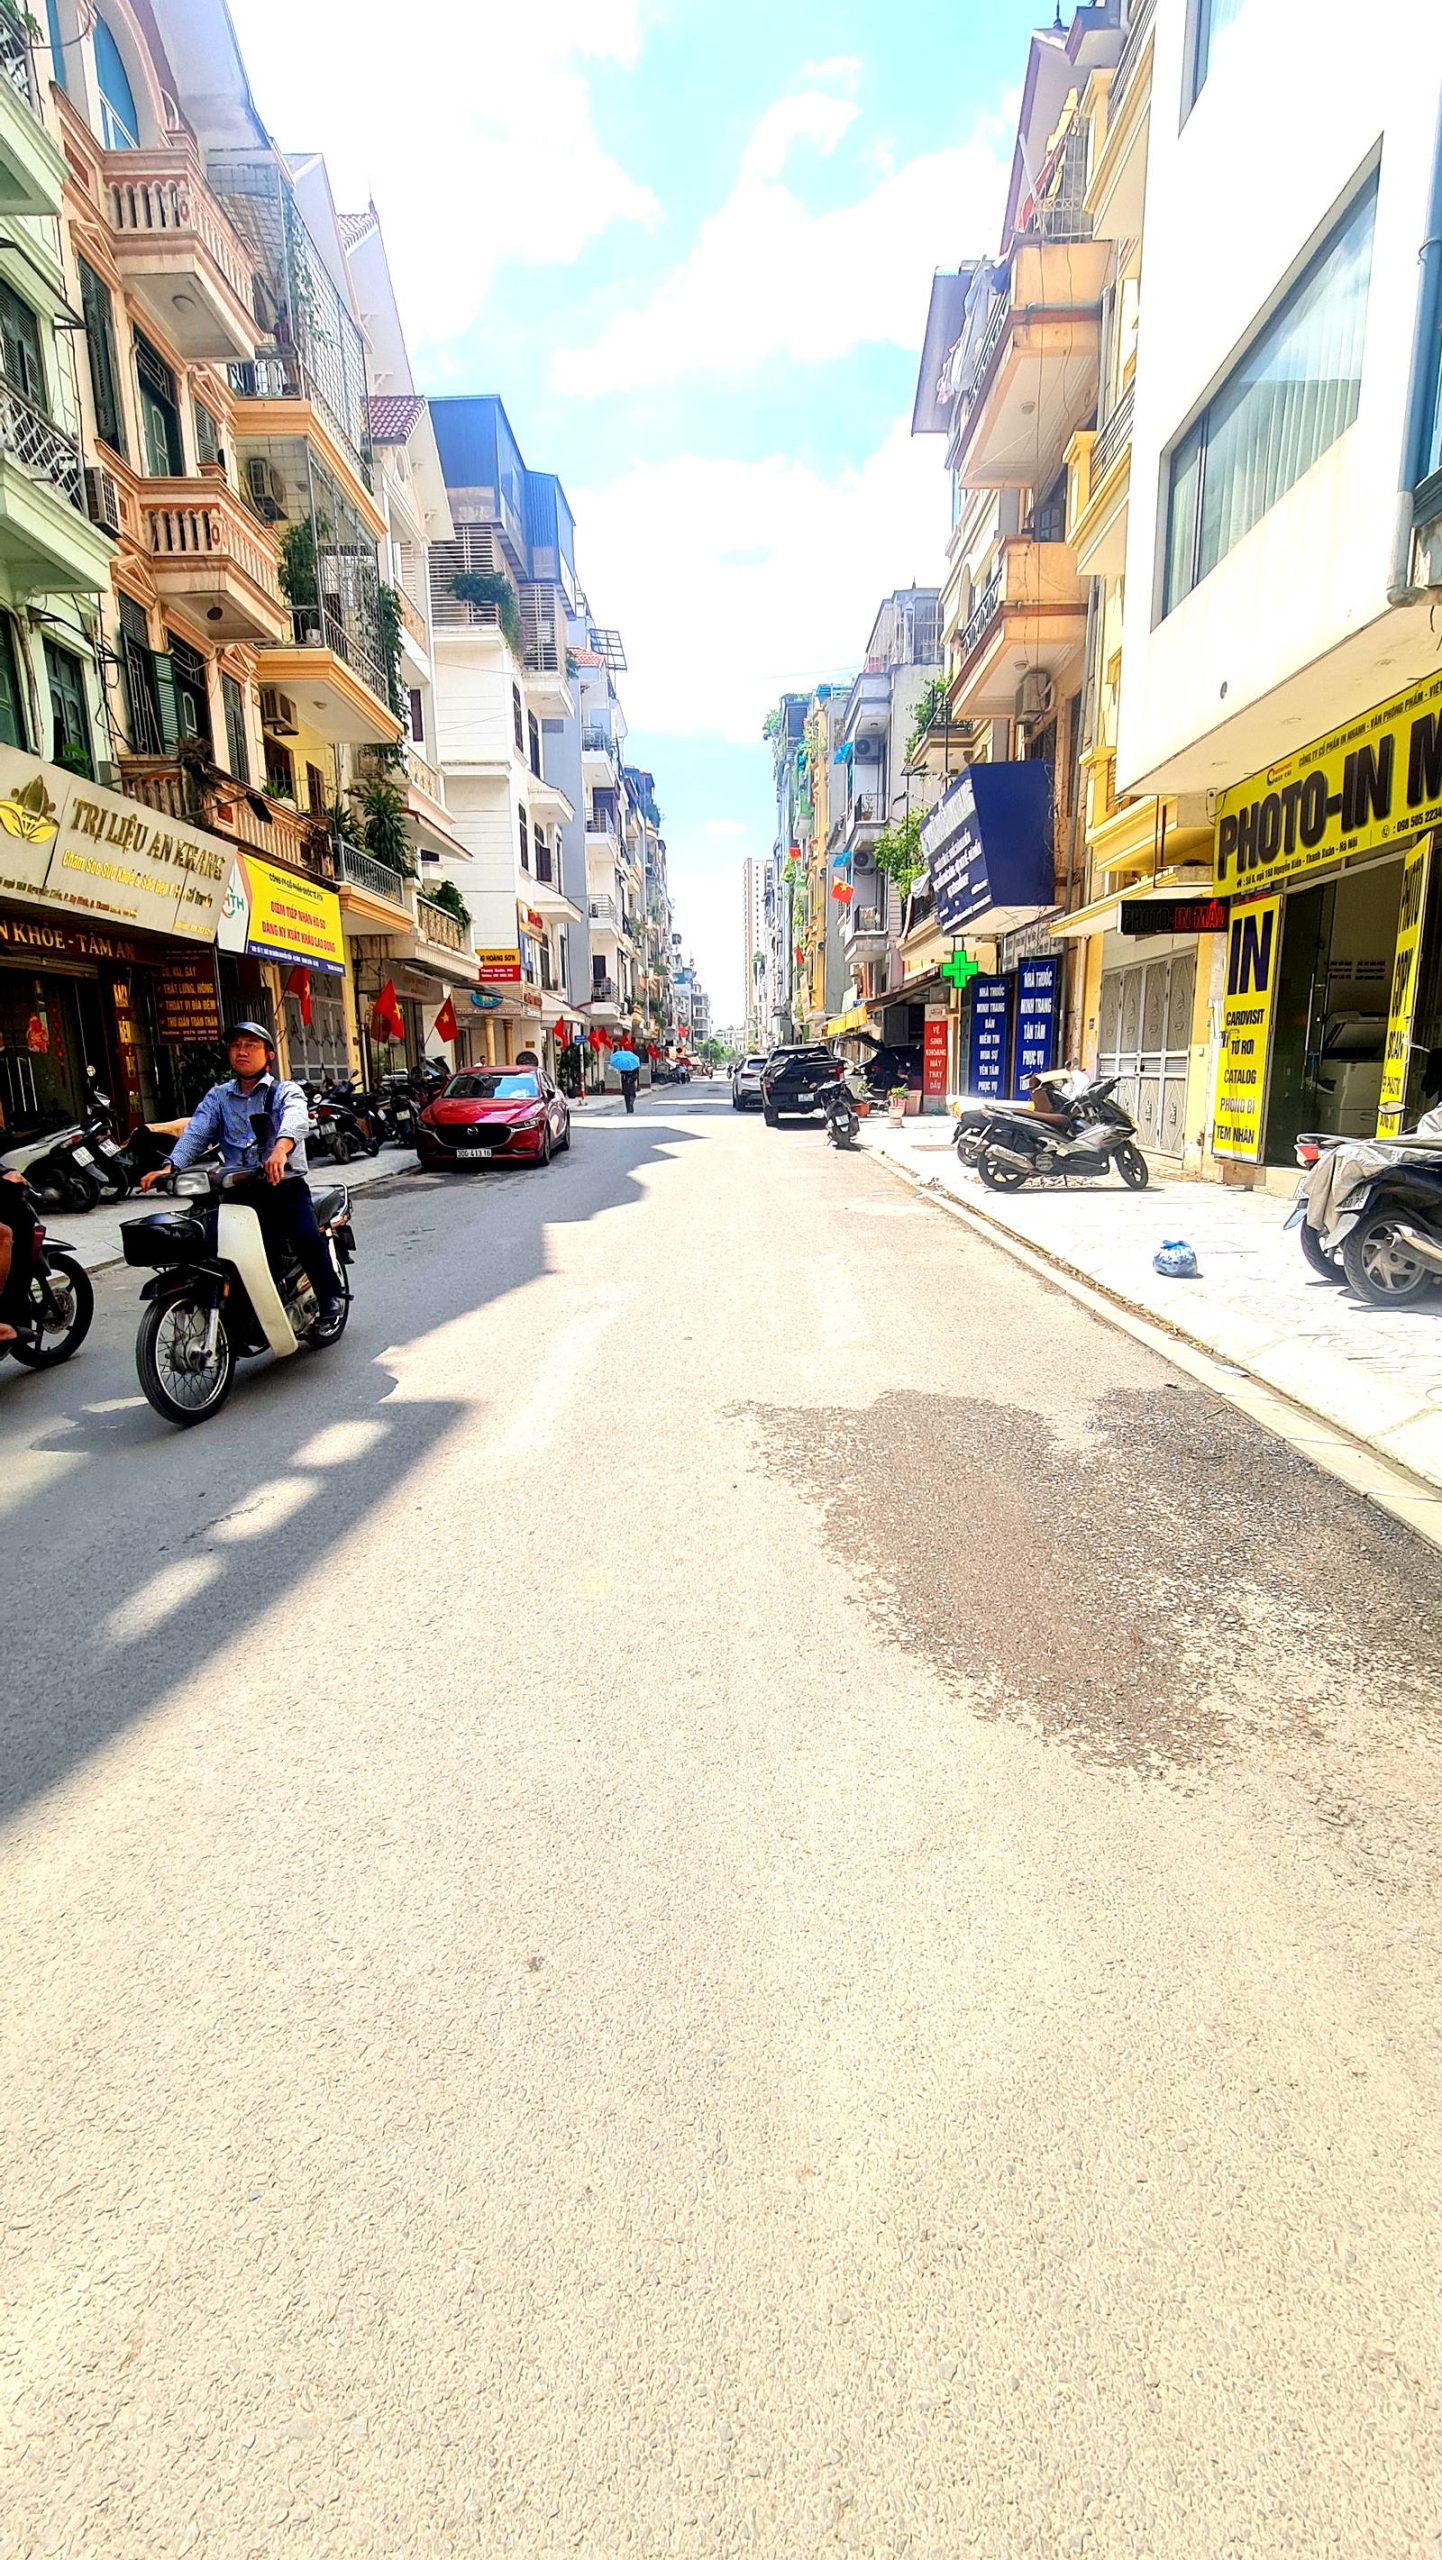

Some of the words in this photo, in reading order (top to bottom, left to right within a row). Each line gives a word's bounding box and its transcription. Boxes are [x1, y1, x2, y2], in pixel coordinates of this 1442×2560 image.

[1312, 749, 1318, 760] TY
[1347, 723, 1366, 740] NHANH
[1370, 714, 1383, 730] VĂN
[1383, 702, 1404, 721] PHÒNG
[1404, 689, 1423, 710] PHẨM
[1217, 733, 1395, 881] PHOTO-IN
[1397, 819, 1409, 832] 098
[71, 798, 108, 844] TRỊ
[105, 813, 149, 855] LIỆU
[146, 831, 174, 862] AN
[172, 839, 226, 881] KHANG
[1306, 851, 1321, 864] Thanh
[1321, 845, 1335, 859] Xuân
[1339, 841, 1347, 852] Hà
[1348, 836, 1358, 851] Nội
[270, 898, 285, 917] ĐIỂM
[285, 904, 298, 920] TIẾP
[76, 931, 113, 957] TÂM
[261, 920, 279, 936] ĐĂNG
[287, 927, 301, 943] XUẤT
[301, 930, 315, 947] KHẨU
[324, 939, 336, 953] ĐỘNG
[486, 953, 504, 961] HOÀNG
[1227, 909, 1275, 996] IN
[1024, 968, 1035, 988] NHÀ
[1035, 965, 1053, 988] THUỐC
[979, 985, 989, 997] NHÀ
[990, 984, 1005, 997] THUỐC
[976, 1003, 989, 1013] MINH
[990, 1002, 1005, 1013] TRANG
[1020, 998, 1035, 1014] MINH
[1035, 998, 1052, 1014] TRANG
[985, 1017, 995, 1028] BÁN
[1226, 1009, 1265, 1026] CARDVISIT
[992, 1034, 1000, 1044] TIN
[1023, 1021, 1034, 1043] TẬN
[1034, 1021, 1046, 1040] TÂM
[930, 1037, 943, 1045] SINH
[1231, 1035, 1240, 1055] TỜ
[1241, 1038, 1254, 1055] RƠI
[926, 1049, 947, 1057] KHOANG
[980, 1050, 990, 1060] MUA
[1022, 1050, 1037, 1069] PHỤC
[1037, 1050, 1045, 1069] VỤ
[929, 1058, 942, 1067] MÁY
[989, 1064, 999, 1075] TÂM
[929, 1071, 943, 1079] THAY
[1224, 1069, 1257, 1084] CATALOG
[978, 1081, 991, 1093] PHỤC
[991, 1081, 998, 1093] VỤ
[1220, 1098, 1245, 1113] PHONG
[1246, 1097, 1255, 1114] BÌ
[1216, 1125, 1231, 1140] TEM
[1232, 1125, 1255, 1144] NHÃN
